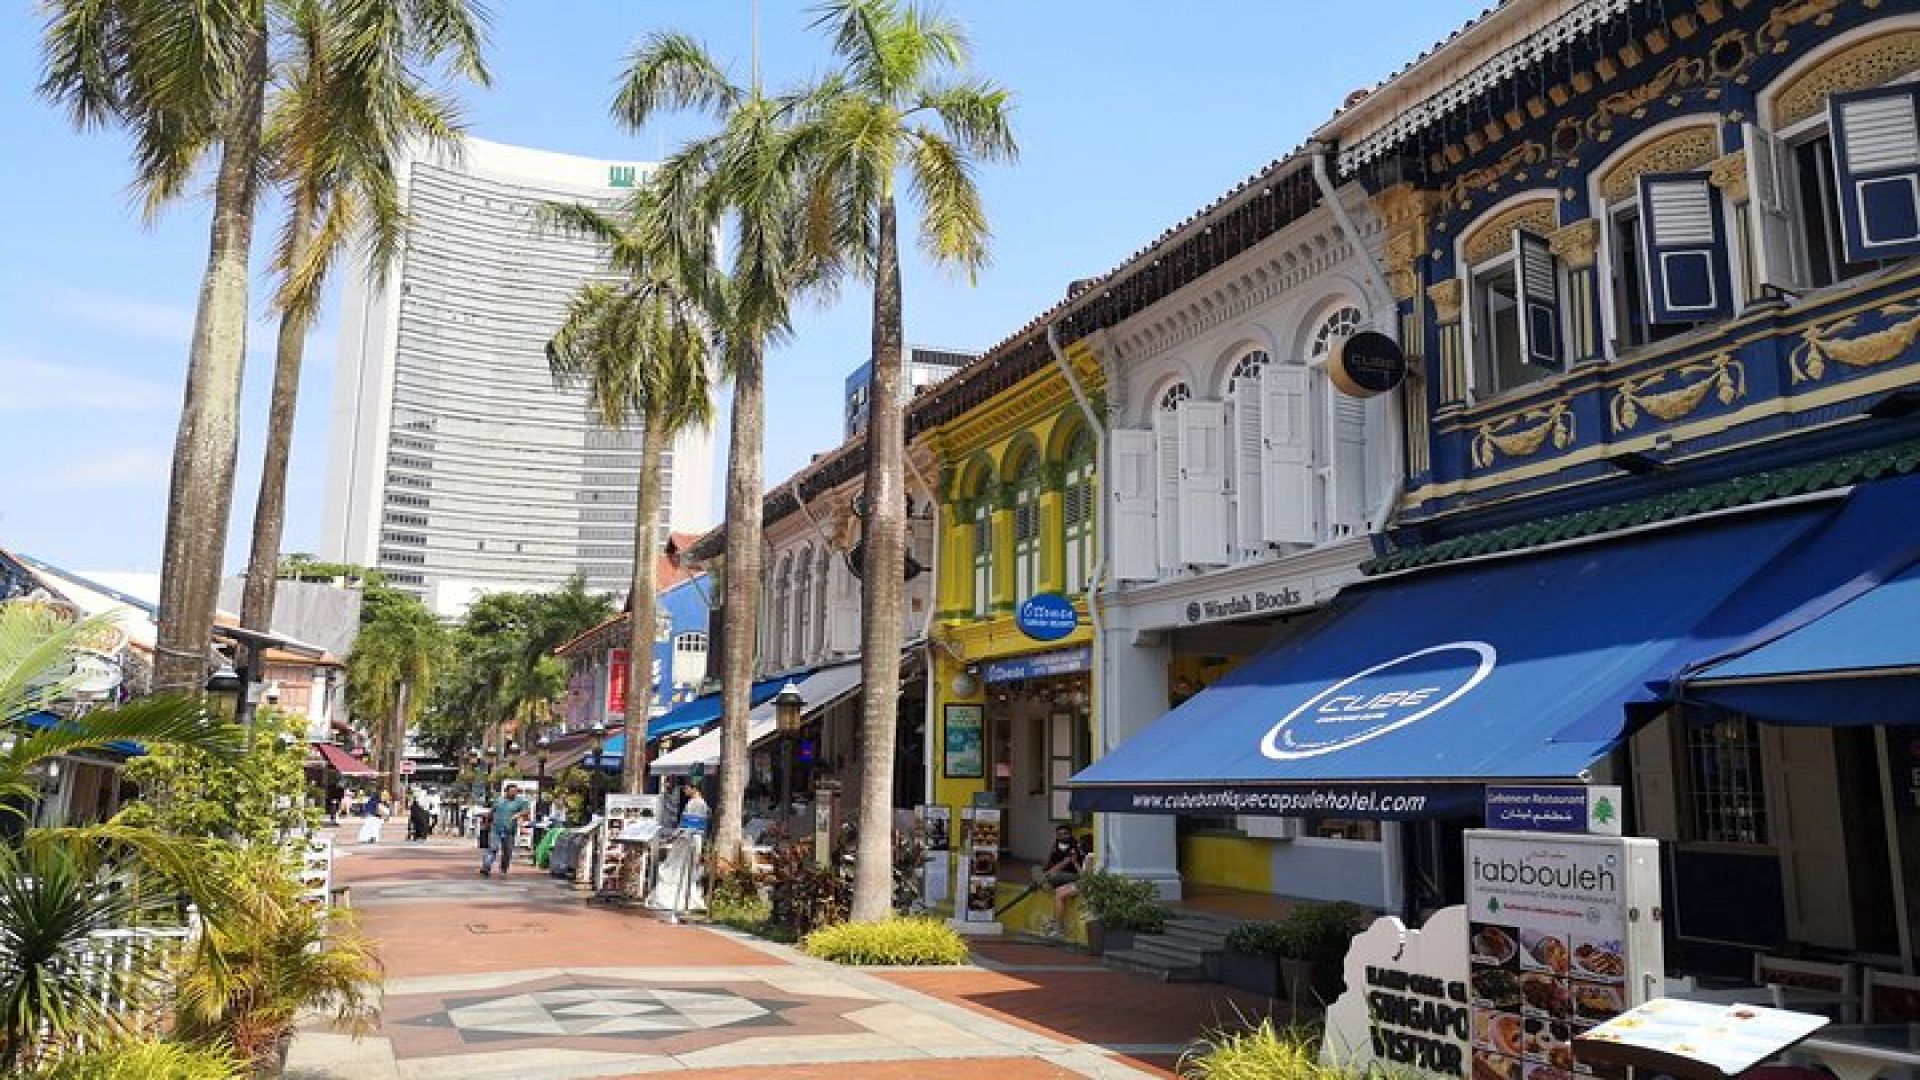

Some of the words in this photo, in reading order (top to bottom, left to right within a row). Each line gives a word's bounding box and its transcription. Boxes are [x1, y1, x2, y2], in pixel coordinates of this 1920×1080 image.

[1256, 587, 1301, 610] Books
[1316, 686, 1440, 712] CUBE
[1533, 793, 1585, 804] Restaurant
[1472, 855, 1616, 891] tabbouleh
